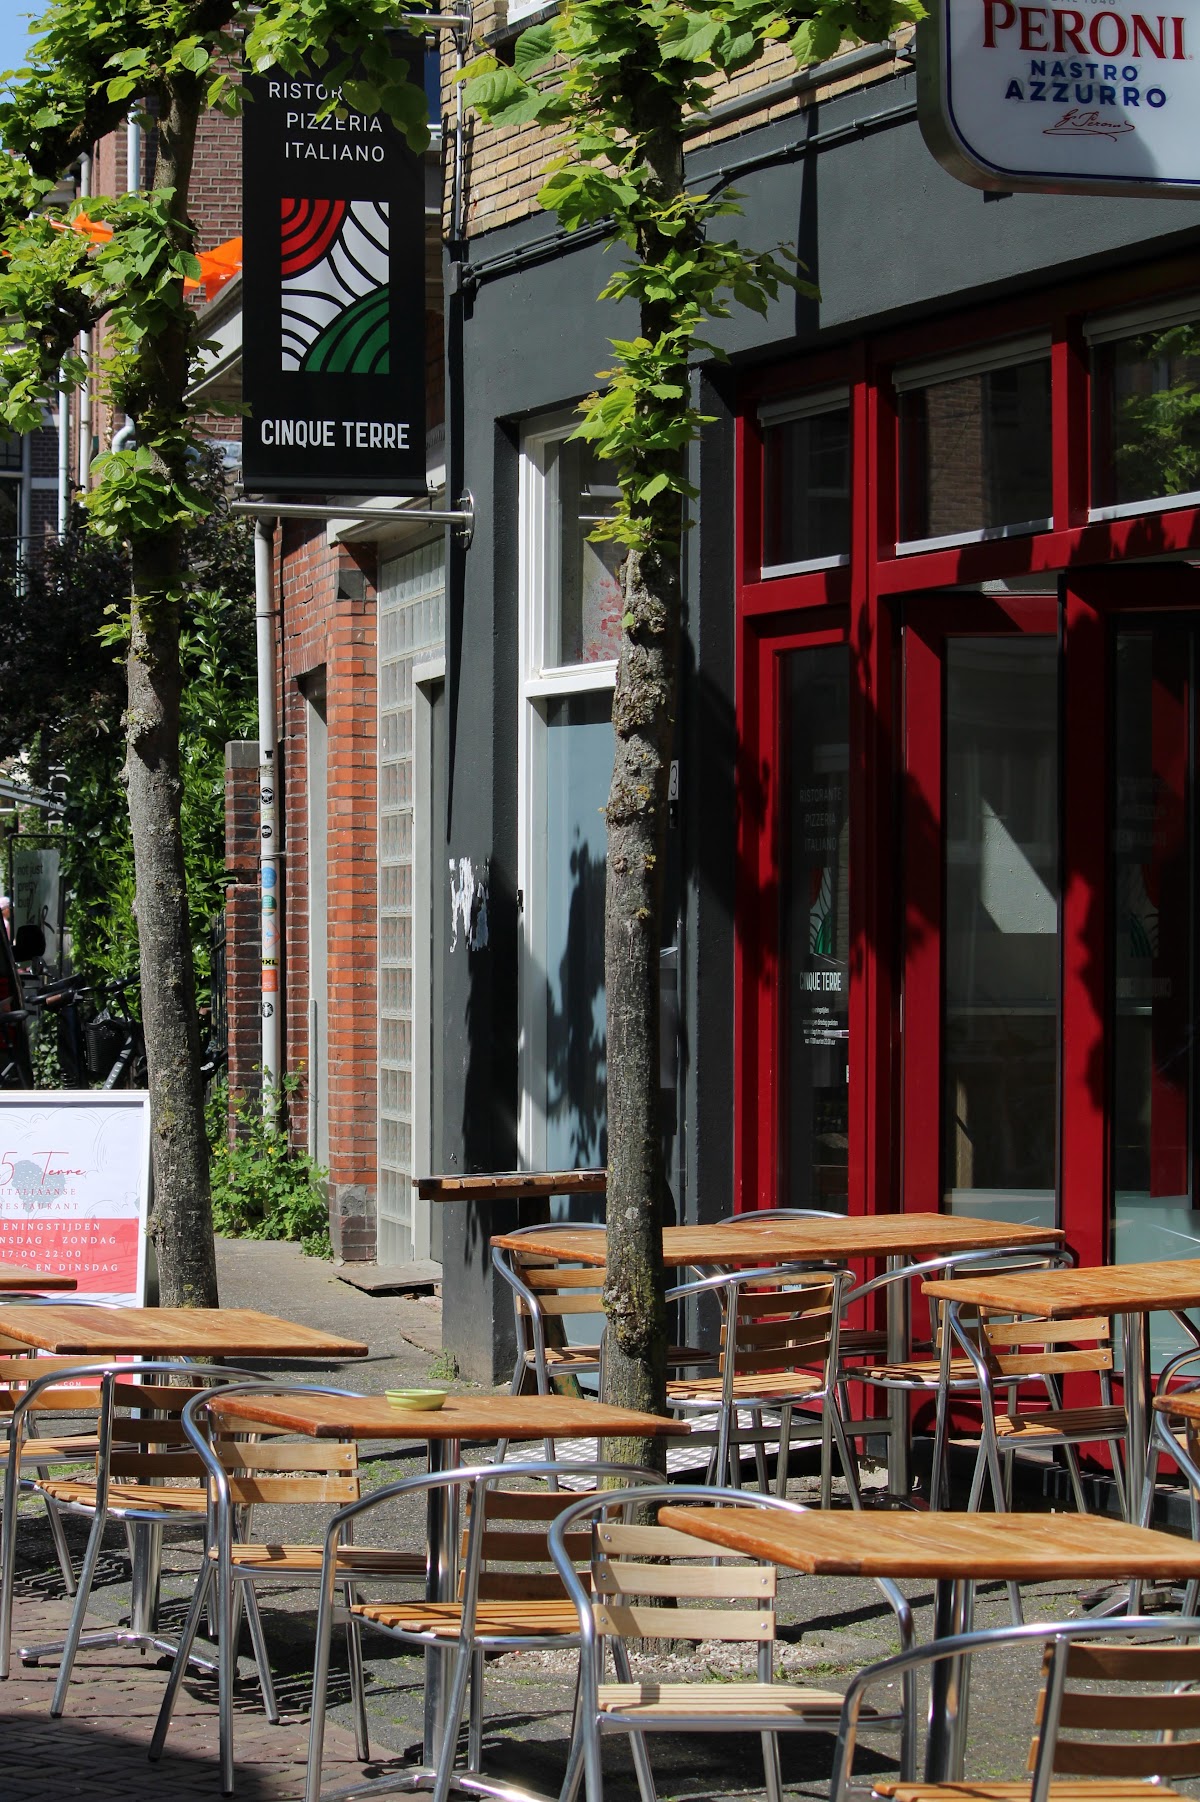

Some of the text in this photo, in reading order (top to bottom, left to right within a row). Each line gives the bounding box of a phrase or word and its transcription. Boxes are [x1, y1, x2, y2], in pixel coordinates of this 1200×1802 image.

[982, 0, 1187, 60] PERONI
[1030, 59, 1138, 82] NASTRO
[268, 81, 343, 101] RISTOR
[1004, 80, 1167, 108] AZZURRO
[286, 112, 383, 133] PIZZERIA
[285, 142, 385, 163] ITALIANO
[261, 419, 410, 450] CINQUE TERRE
[821, 971, 842, 992] TERRE
[0, 1151, 87, 1187] 5 Terre
[1, 1188, 76, 1196] ITALIAANSE
[62, 1236, 117, 1245] ZONDAG
[1, 1250, 82, 1258] 17:00-22:00
[36, 1263, 51, 1272] EN
[59, 1263, 118, 1272] DINSDAG
